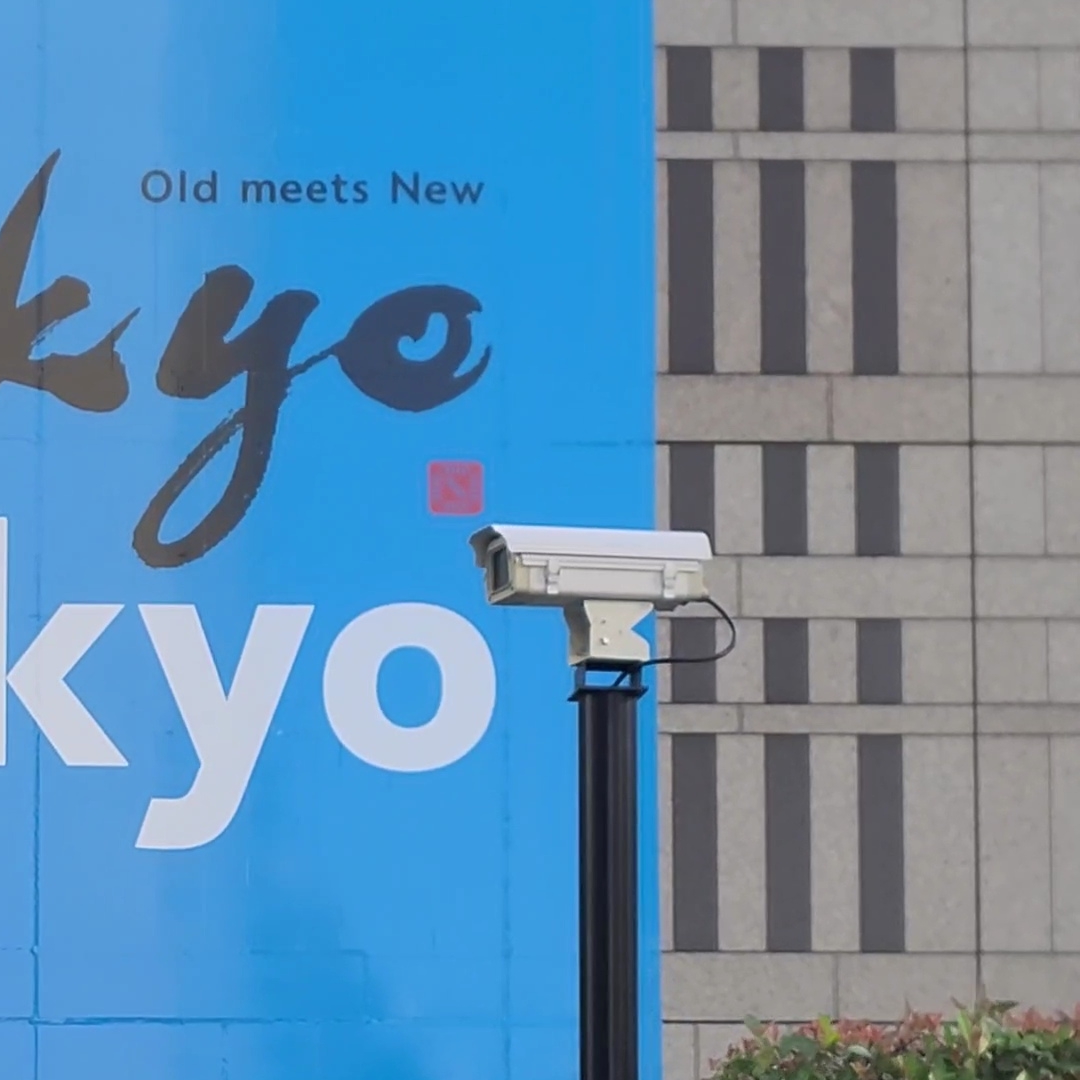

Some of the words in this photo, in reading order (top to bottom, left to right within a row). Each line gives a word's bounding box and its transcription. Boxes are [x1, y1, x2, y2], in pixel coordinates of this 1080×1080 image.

[141, 169, 218, 204] Old
[241, 173, 369, 205] meets
[390, 170, 486, 206] New
